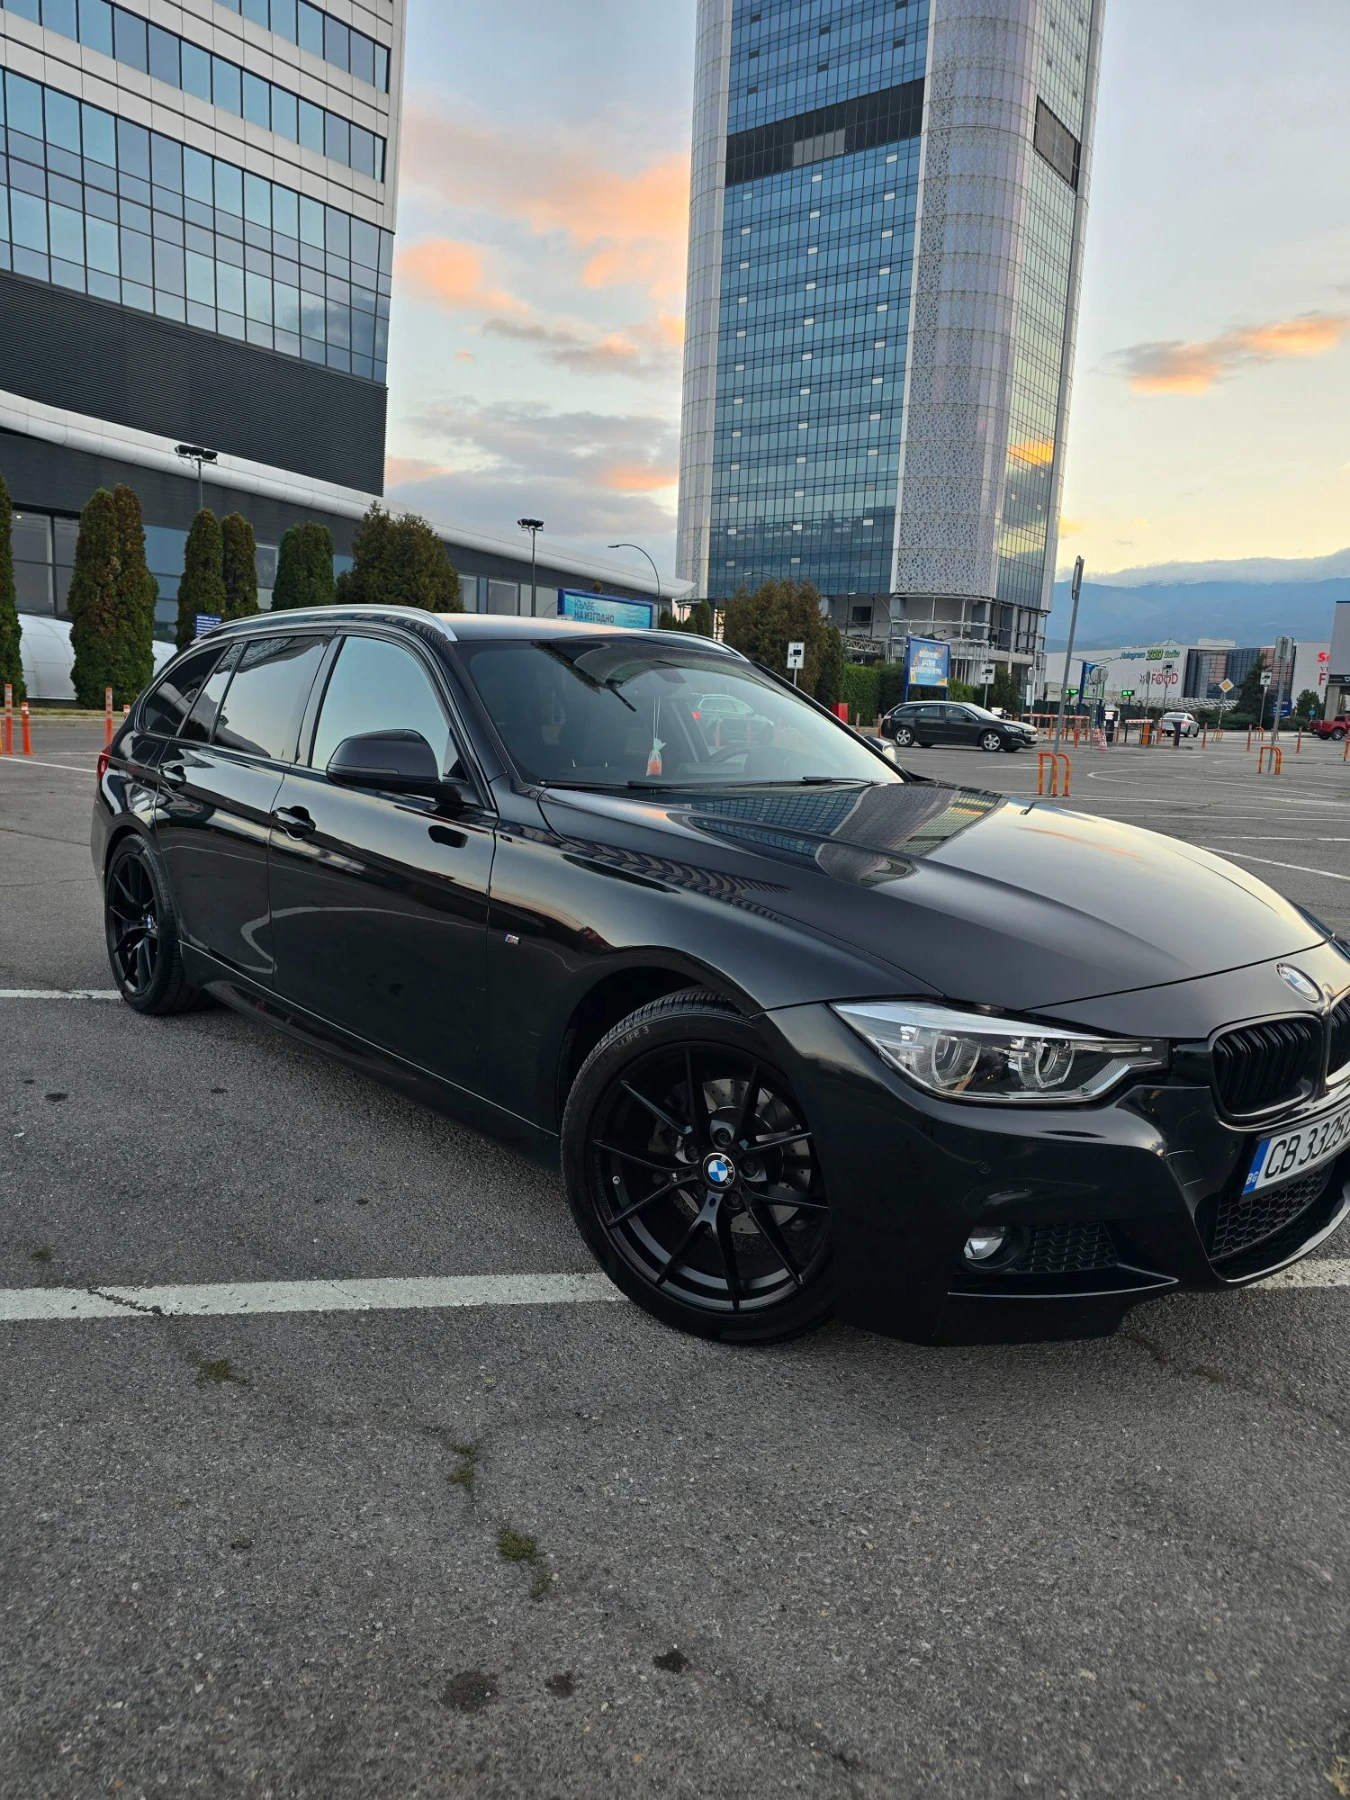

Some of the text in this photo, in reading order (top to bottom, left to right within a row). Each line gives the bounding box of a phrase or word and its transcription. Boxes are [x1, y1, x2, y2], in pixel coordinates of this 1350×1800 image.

[574, 610, 615, 623] НА ИЗГОДНО
[1151, 673, 1178, 685] FOOD
[1265, 1134, 1301, 1179] CB
[1246, 1171, 1259, 1186] BG
